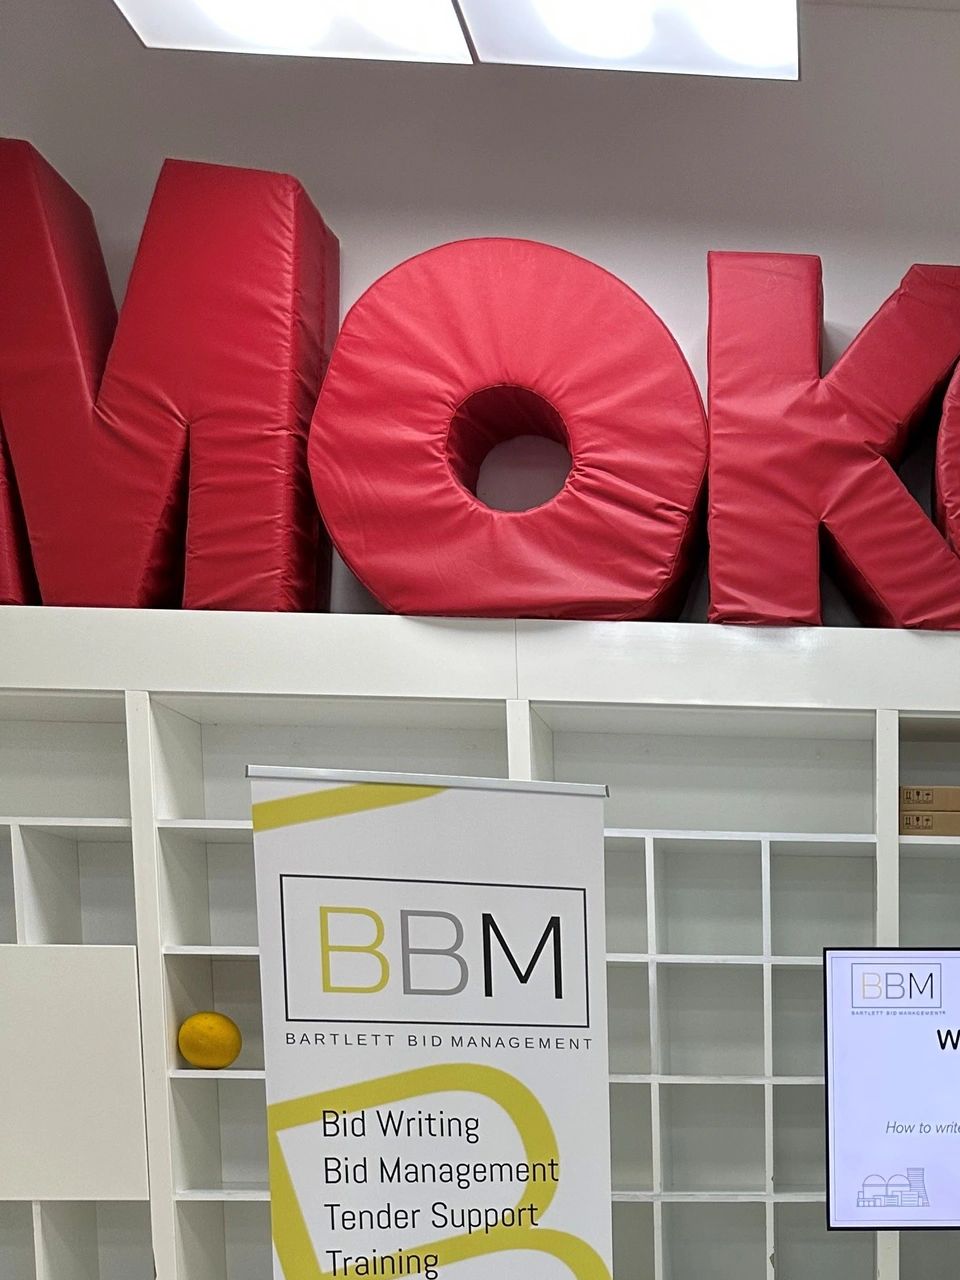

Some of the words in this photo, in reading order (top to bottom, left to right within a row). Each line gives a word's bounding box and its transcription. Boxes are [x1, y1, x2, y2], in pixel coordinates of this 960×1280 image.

[320, 905, 563, 999] BBM
[862, 972, 933, 1000] BBM
[286, 1032, 395, 1046] BARTLETT
[408, 1035, 442, 1047] BID
[451, 1036, 592, 1050] MANAGEMENT
[322, 1110, 366, 1137] Bid
[376, 1110, 480, 1144] Writing
[886, 1121, 915, 1134] How
[919, 1122, 931, 1134] to
[324, 1157, 368, 1184] Bid
[379, 1157, 559, 1189] Management
[324, 1203, 421, 1230] Tender
[431, 1201, 539, 1234] Support
[326, 1248, 439, 1280] Training
